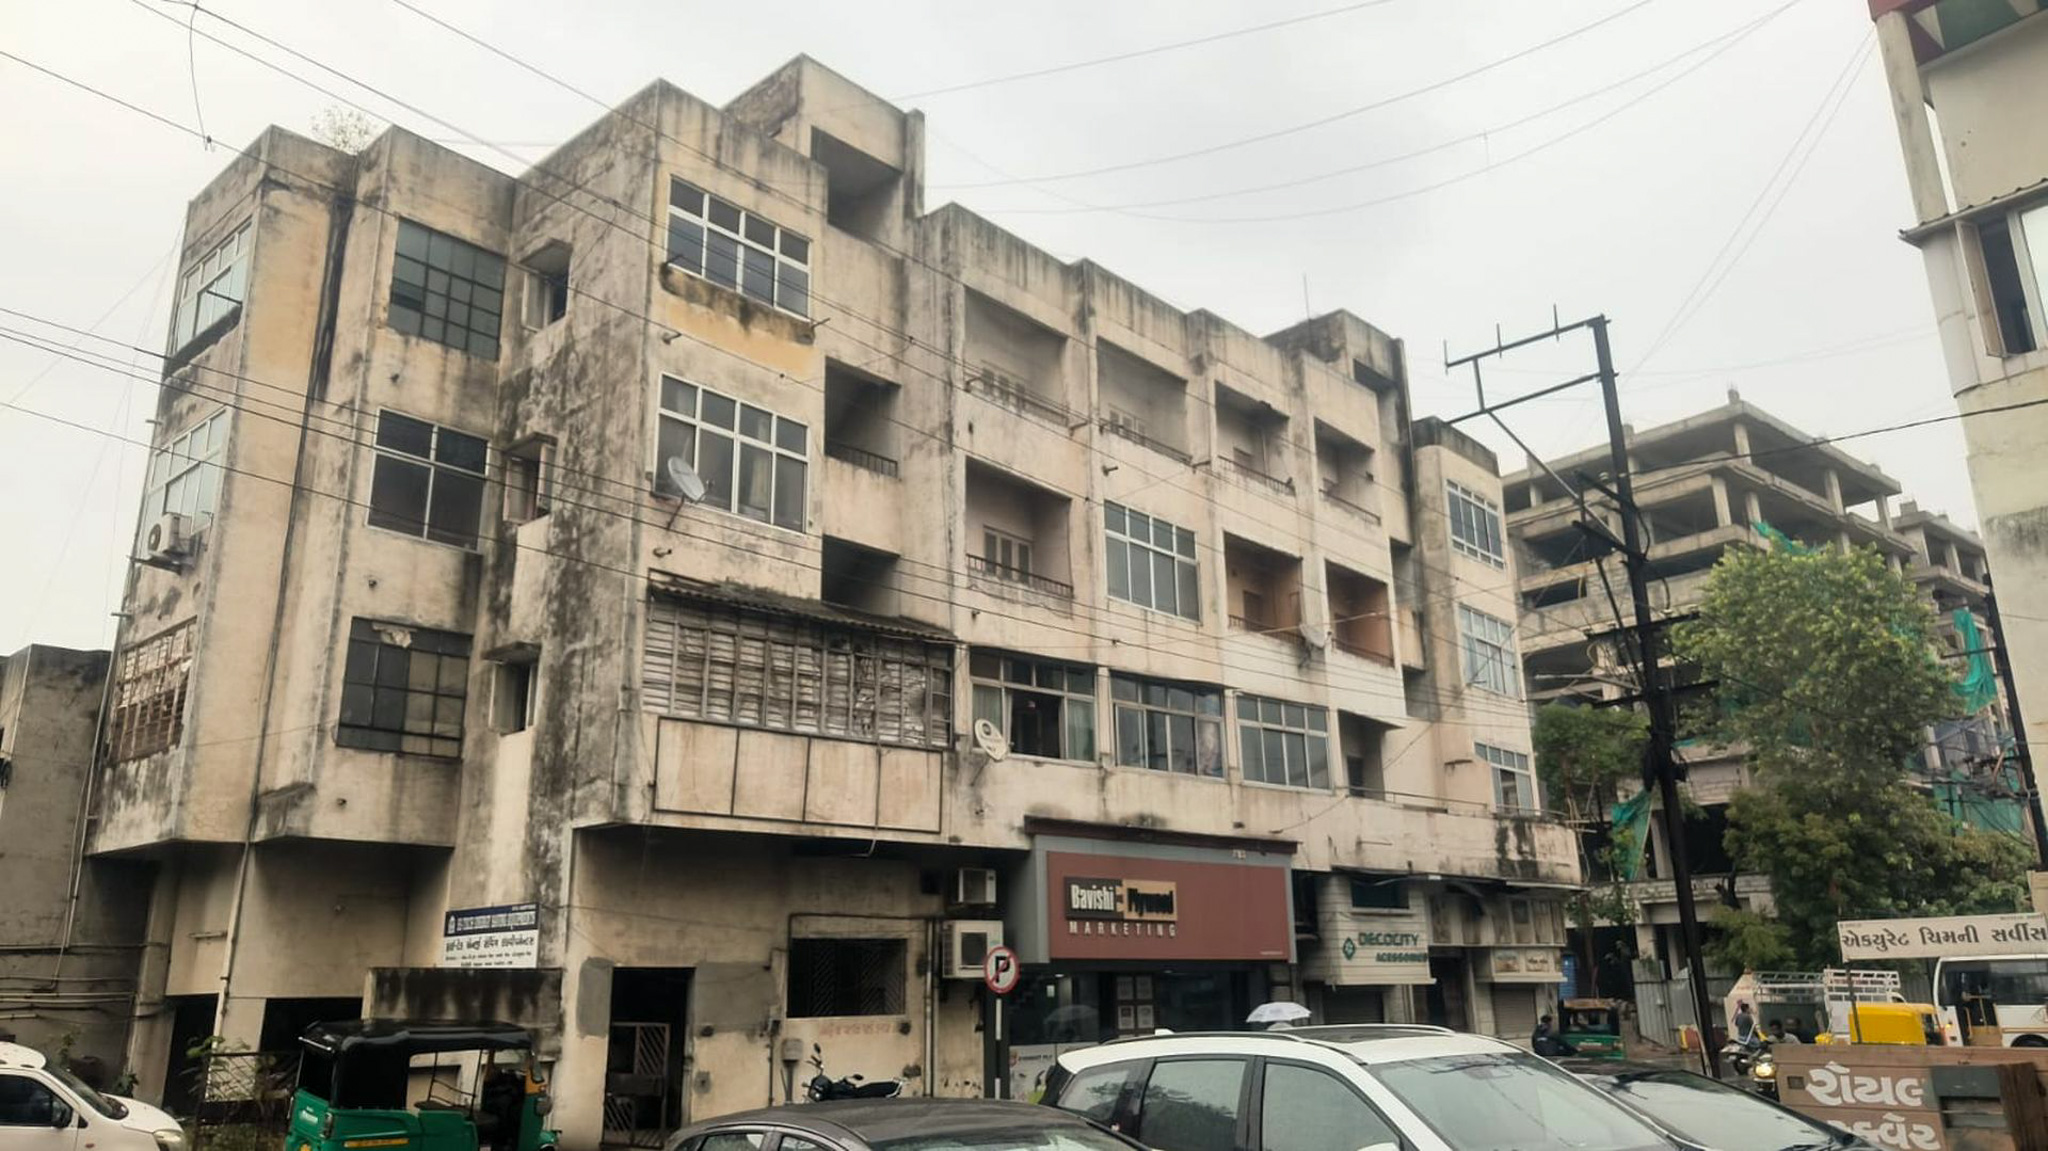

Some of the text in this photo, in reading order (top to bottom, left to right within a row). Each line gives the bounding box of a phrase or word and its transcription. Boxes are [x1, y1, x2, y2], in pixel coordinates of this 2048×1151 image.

[1071, 884, 1115, 911] Bavishi
[1069, 920, 1176, 937] MARKETING
[1358, 931, 1419, 946] DECOCITY
[1918, 925, 1980, 945] ચિમની
[995, 956, 1010, 983] P
